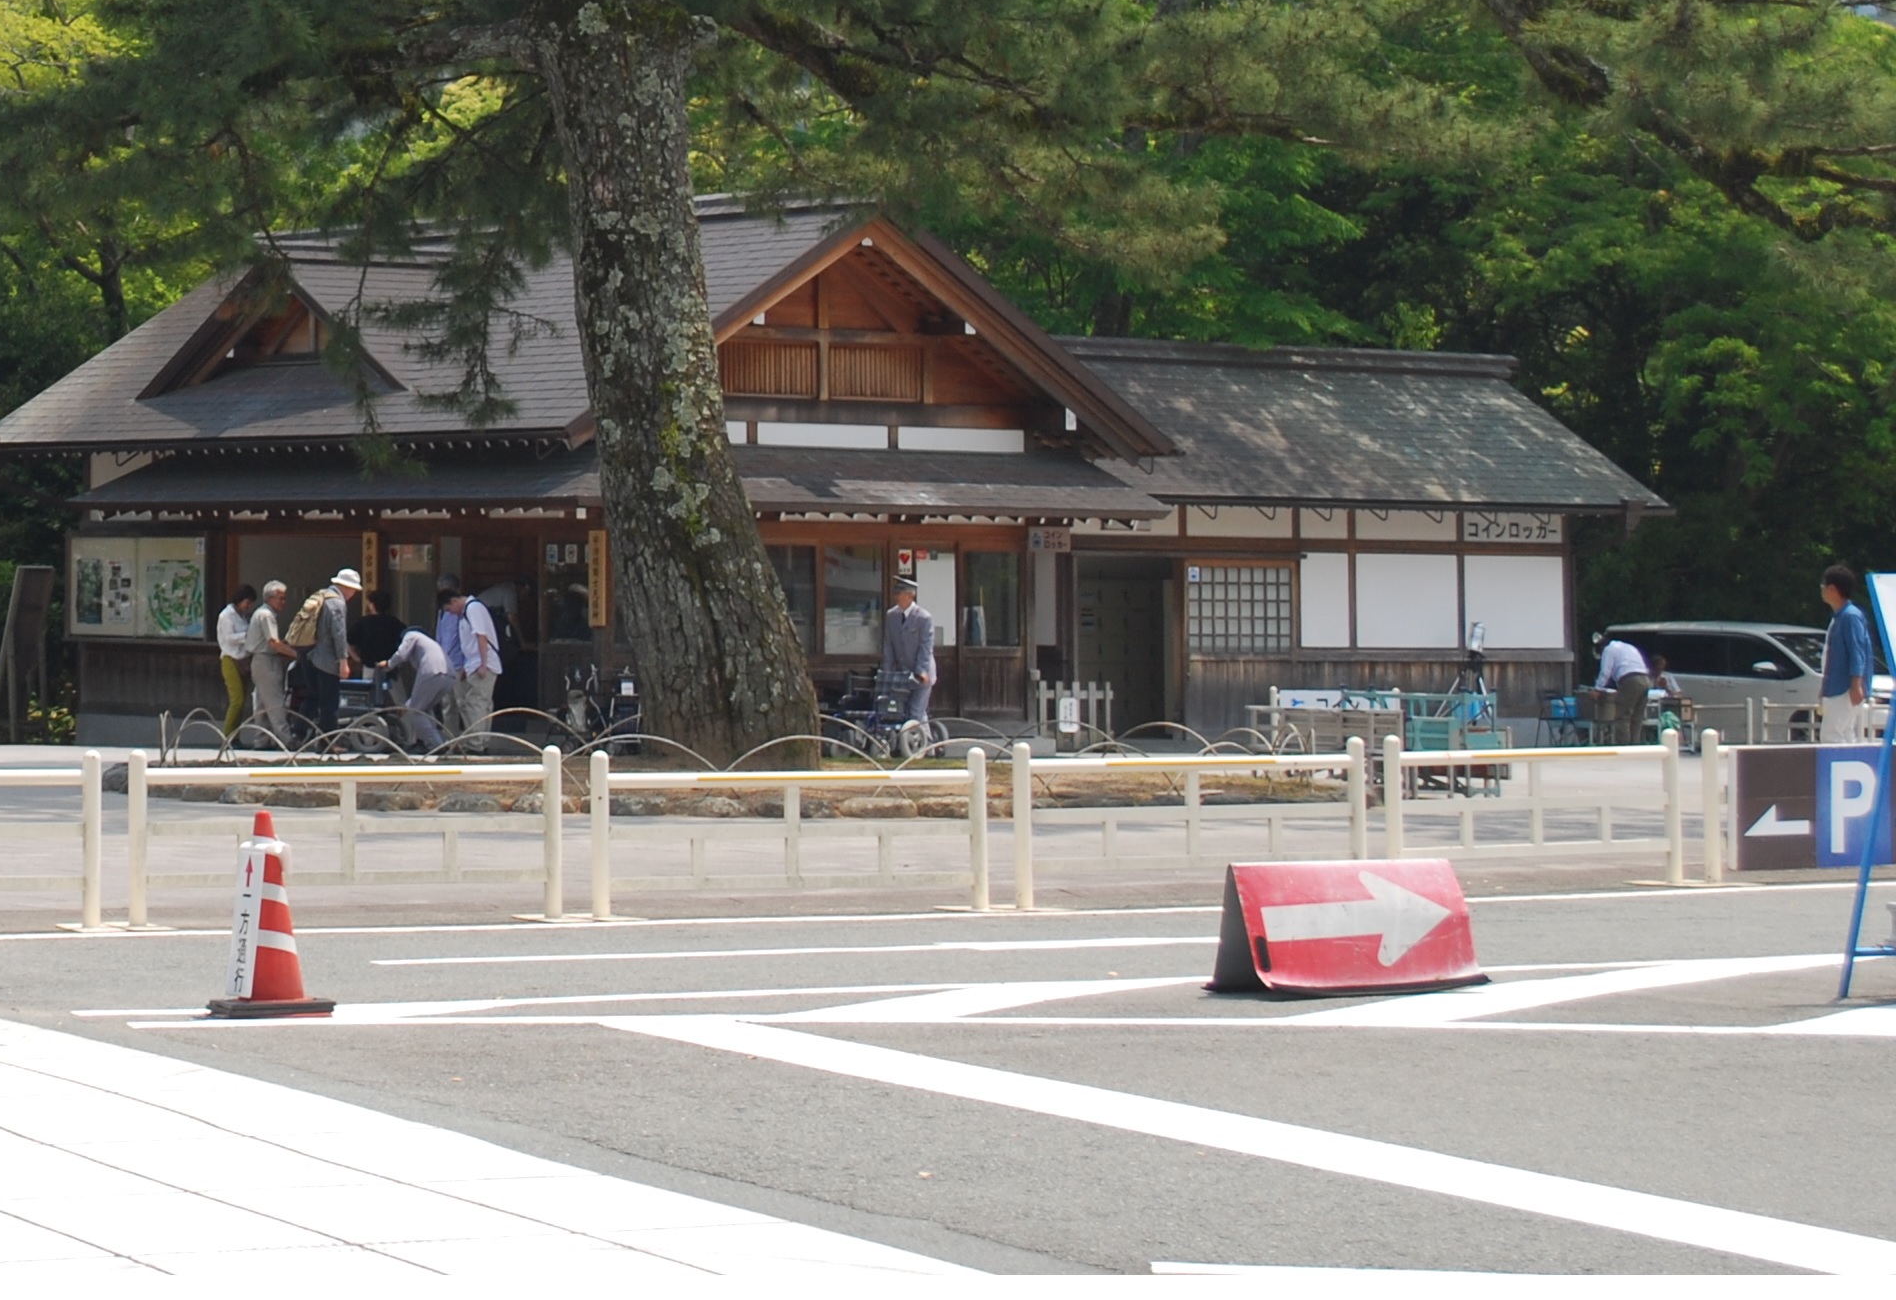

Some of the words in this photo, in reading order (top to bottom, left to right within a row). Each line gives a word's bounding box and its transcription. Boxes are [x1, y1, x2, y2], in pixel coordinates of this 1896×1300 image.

[1468, 522, 1557, 539] コインロッカー
[1830, 761, 1876, 854] P
[233, 892, 252, 993] 一方通行
